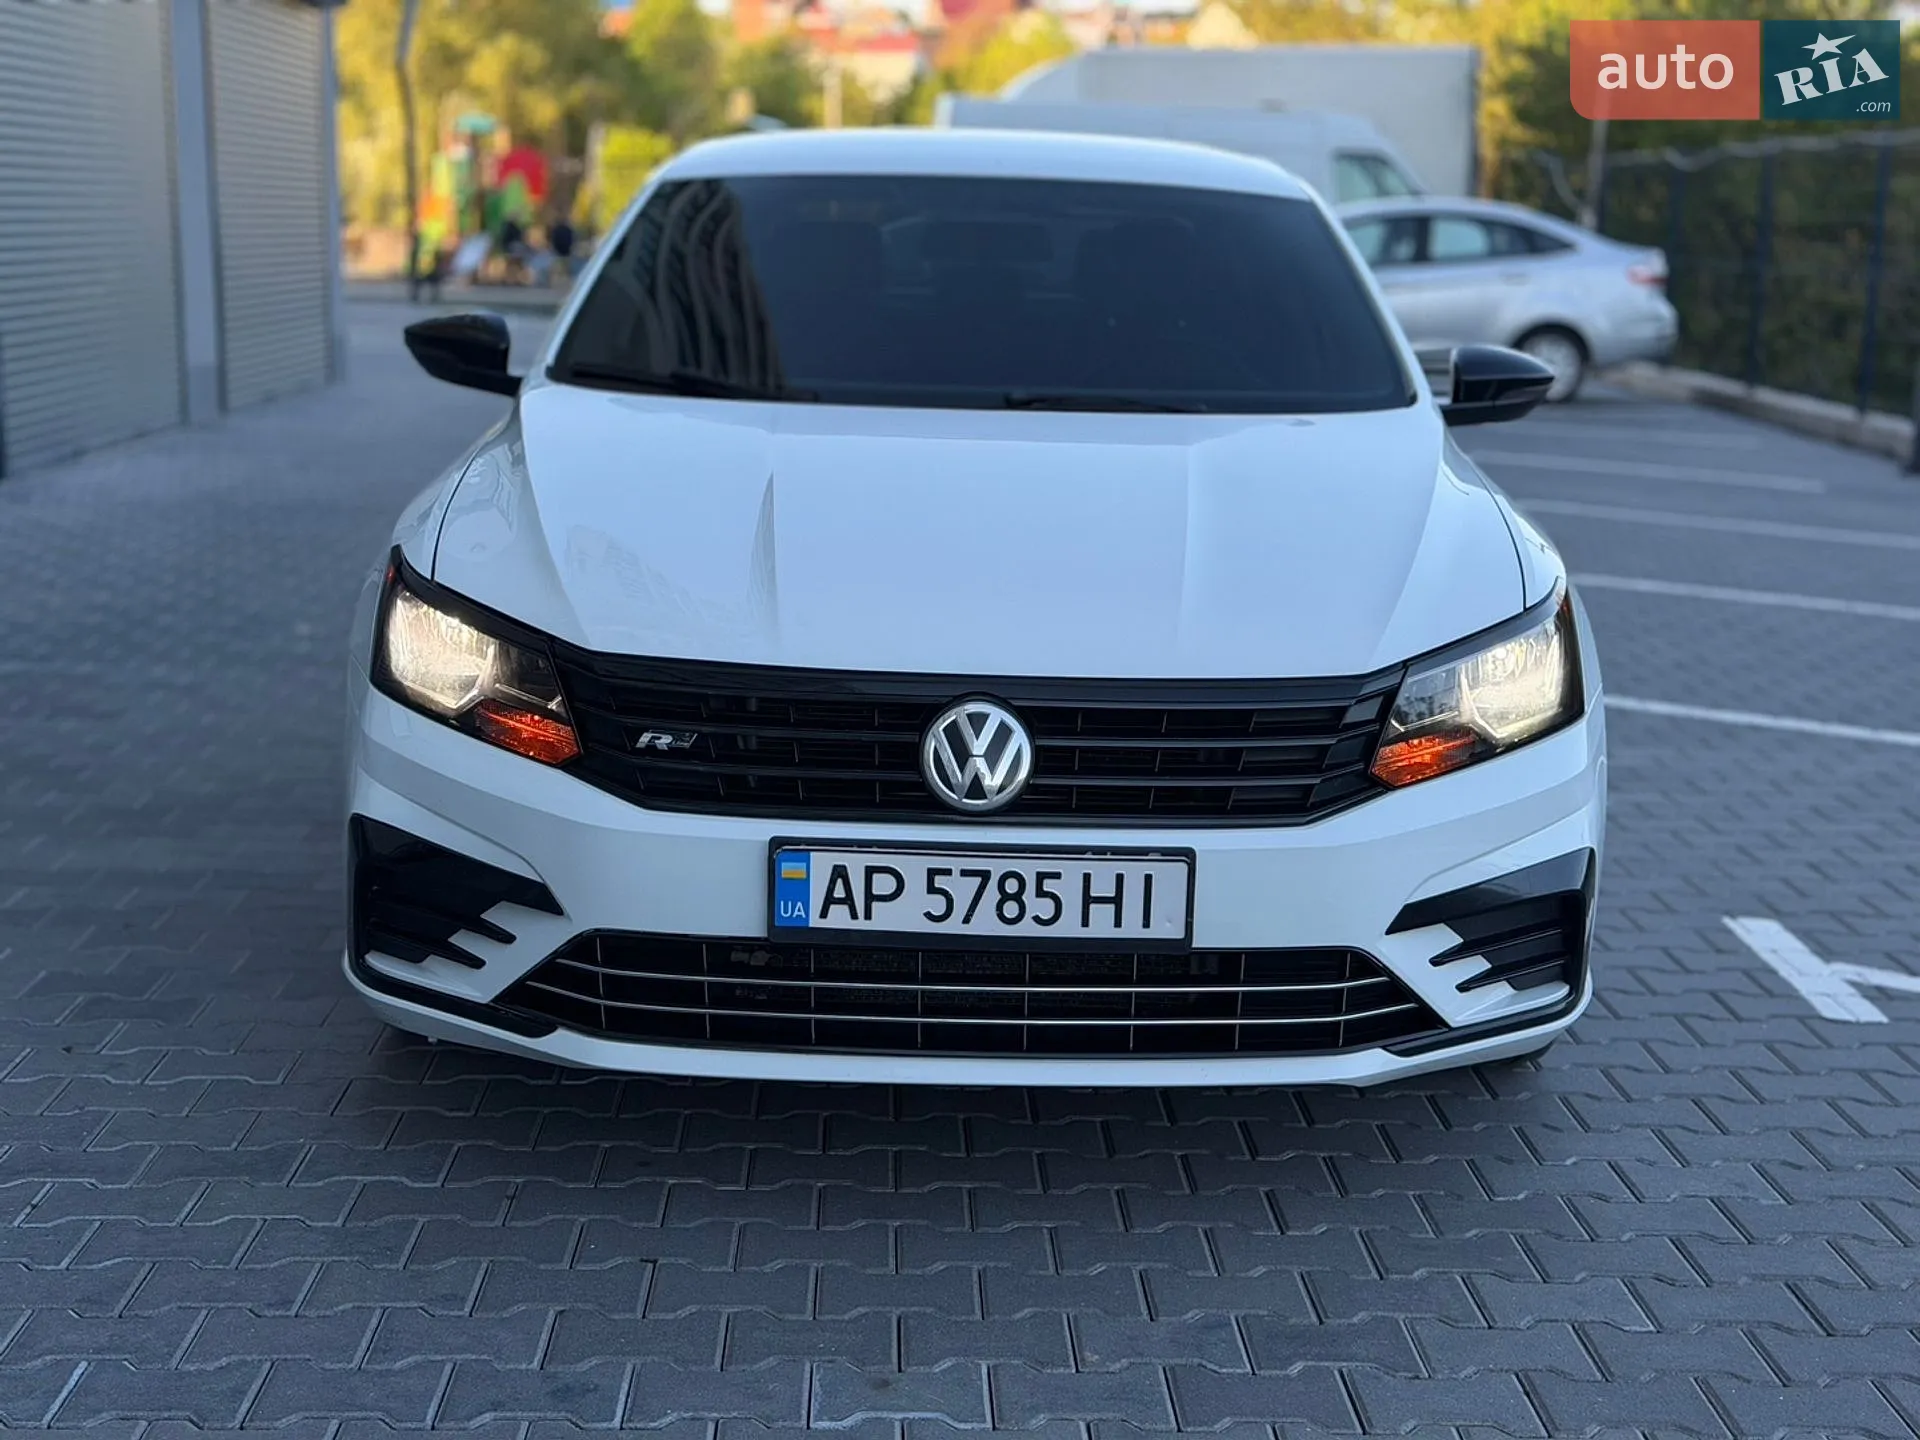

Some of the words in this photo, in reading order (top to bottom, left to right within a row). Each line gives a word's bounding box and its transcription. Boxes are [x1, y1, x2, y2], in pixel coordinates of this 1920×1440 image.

[780, 901, 806, 918] UA
[819, 864, 905, 921] AP
[922, 867, 1063, 927] 5785
[1080, 872, 1153, 929] HI
